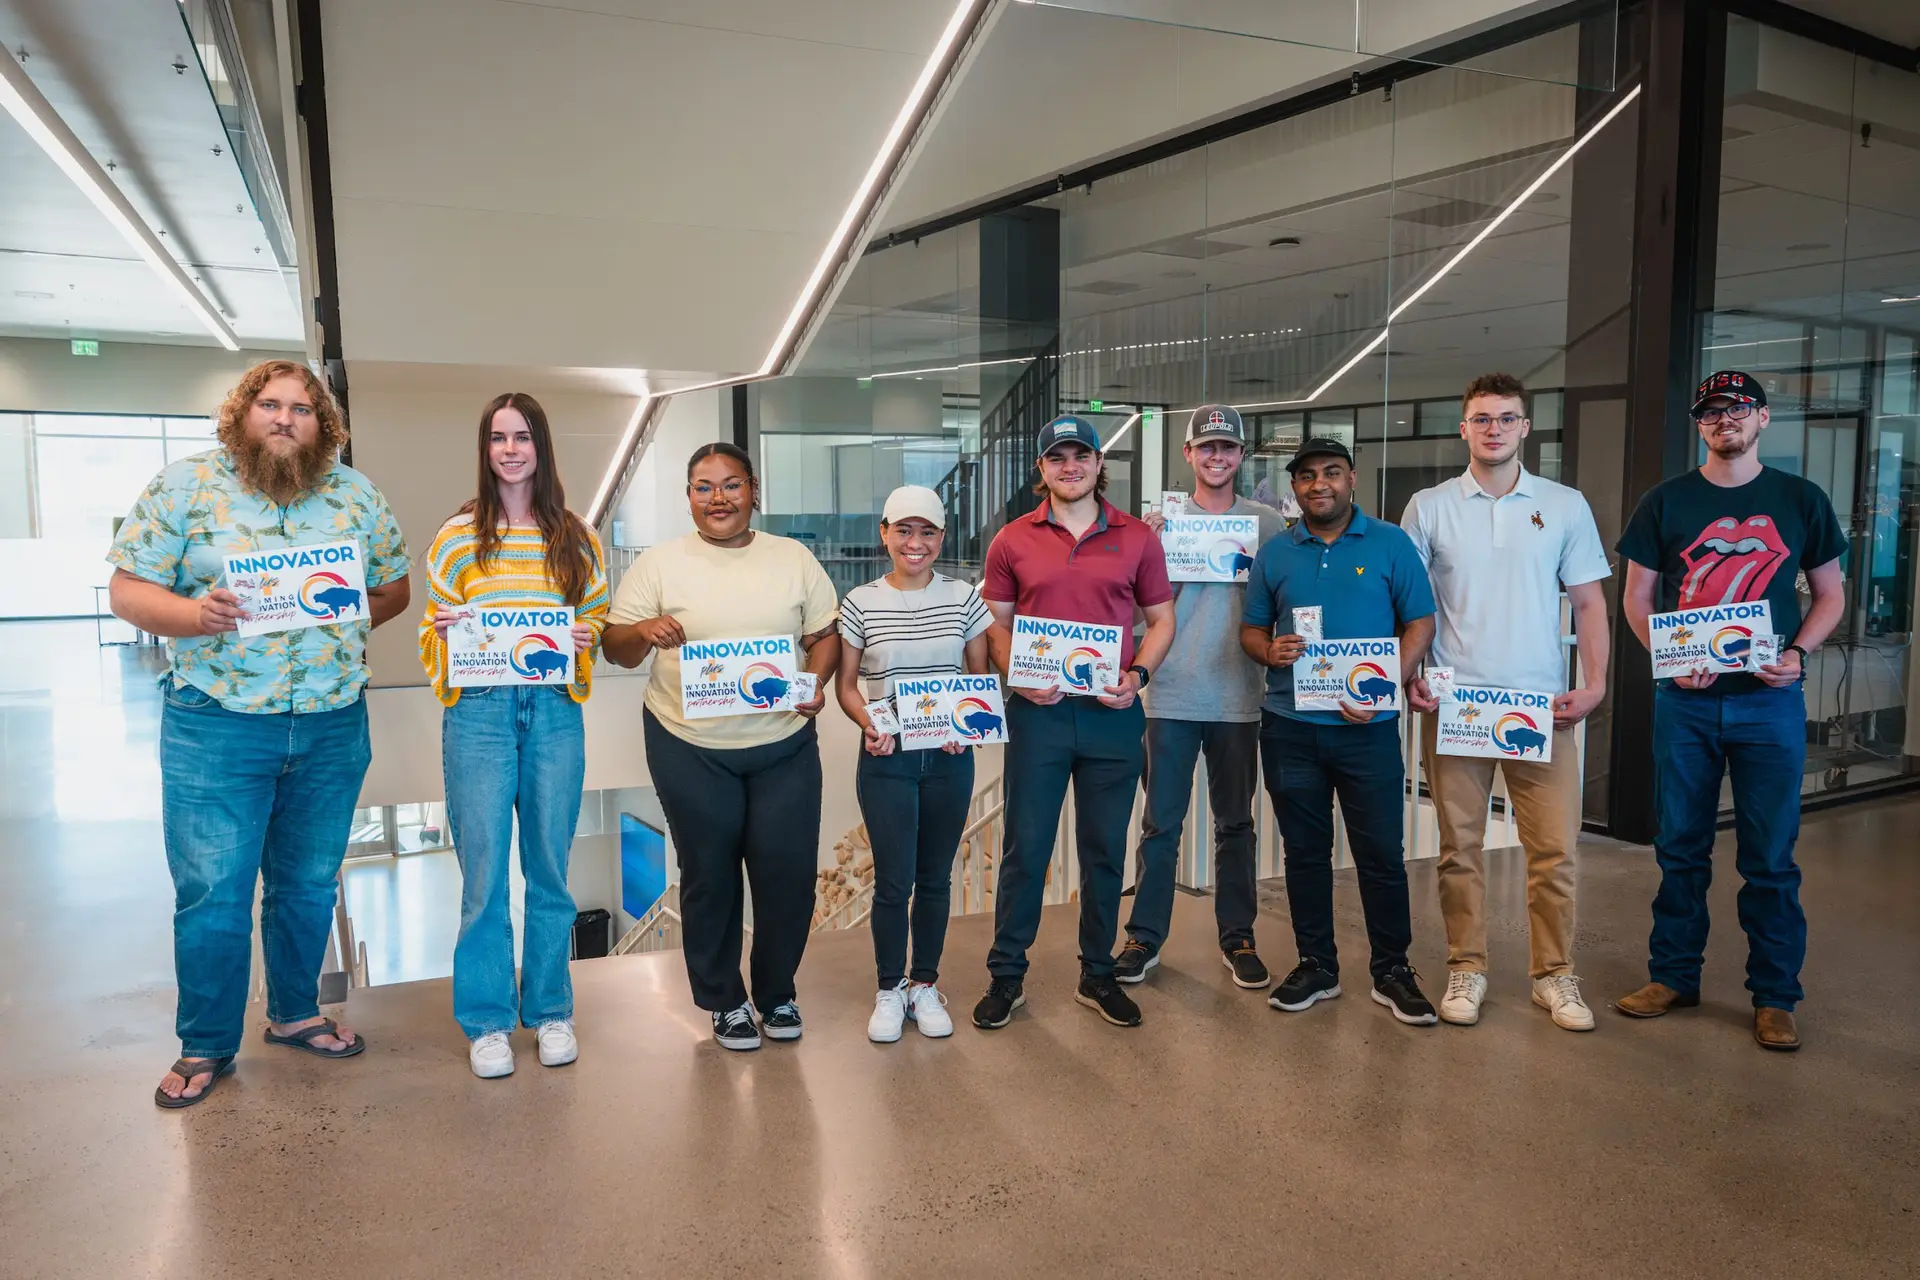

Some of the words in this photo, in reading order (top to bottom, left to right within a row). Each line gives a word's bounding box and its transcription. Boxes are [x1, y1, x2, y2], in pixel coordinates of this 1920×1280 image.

[1201, 422, 1233, 433] LEUPOLD
[1165, 519, 1255, 533] INNOVATOR
[229, 546, 355, 574] INNOVATOR
[259, 576, 280, 589] lus
[1652, 604, 1765, 630] INNOVATOR
[1017, 619, 1118, 644] INNOVATOR
[1669, 629, 1695, 643] plus
[683, 639, 791, 660] INNOVATOR
[1029, 639, 1053, 651] plus
[1655, 643, 1706, 654] WYOMING
[1014, 654, 1060, 665] WYOMING
[1655, 649, 1707, 660] INNOVATION
[453, 658, 507, 666] INNOVATION
[1013, 661, 1060, 672] INNOVATION
[1311, 660, 1333, 674] plus
[1655, 657, 1708, 672] partnership
[452, 665, 507, 681] partnership
[700, 663, 725, 678] plus
[1012, 668, 1059, 684] partnership
[685, 681, 736, 690] WYOMING
[899, 678, 998, 696] INNOVATOR
[686, 688, 736, 698] INNOVATION
[1453, 688, 1549, 709] NNOVATOR
[685, 696, 737, 712] partnership
[915, 698, 938, 713] plus
[903, 714, 949, 723] WYOMING
[1457, 707, 1482, 719] plus
[903, 721, 950, 730] INNOVATION
[1442, 722, 1490, 731] WYOMING
[904, 729, 951, 742] partnership
[1441, 728, 1489, 738] INNOVATION
[1440, 736, 1489, 750] partnership
